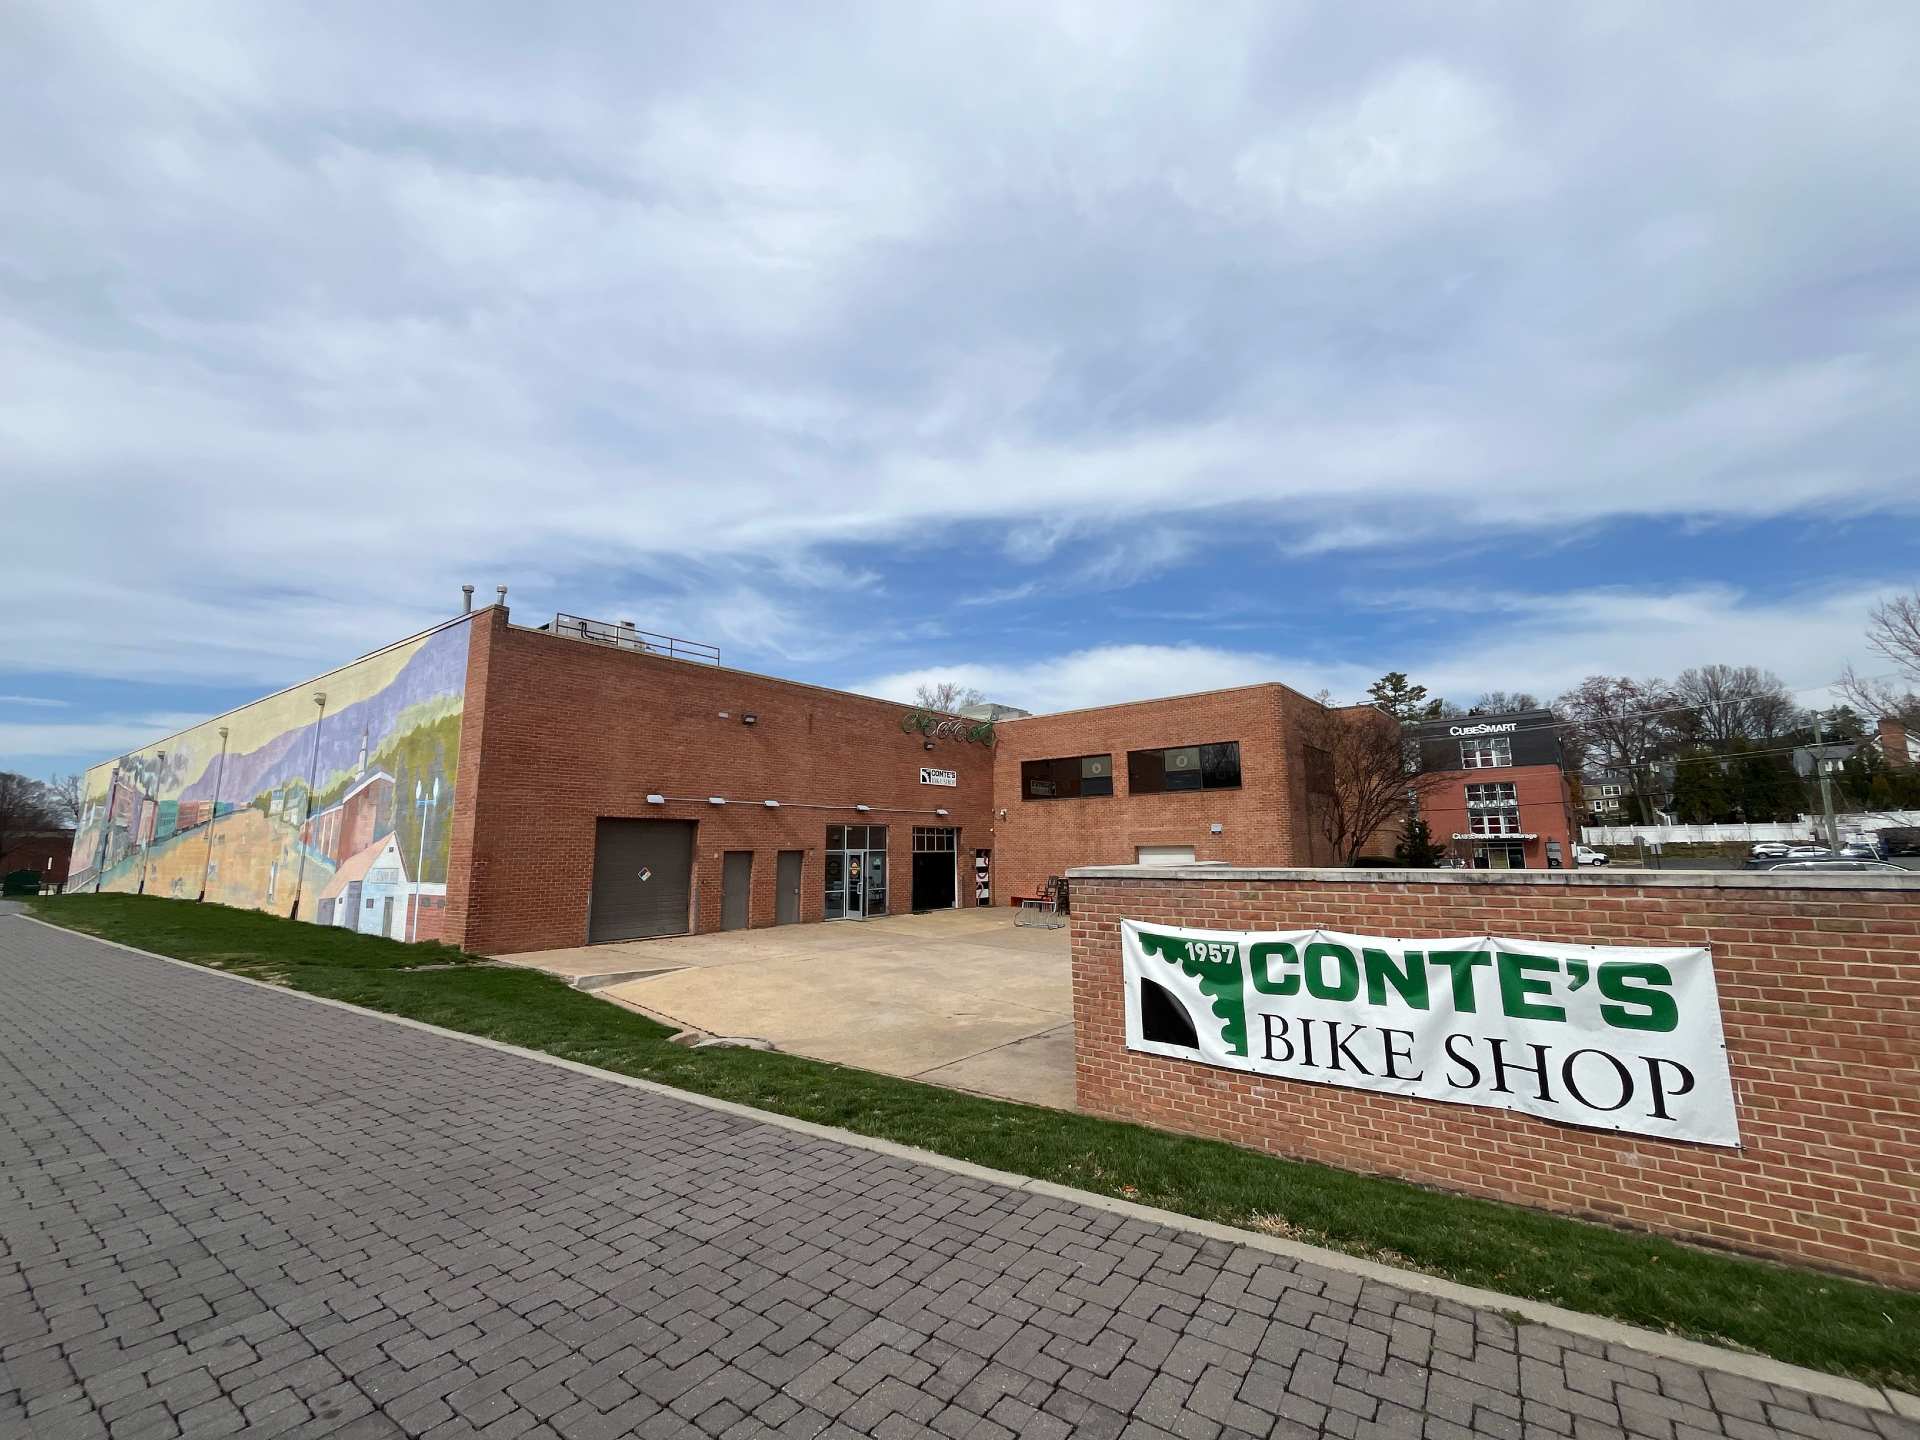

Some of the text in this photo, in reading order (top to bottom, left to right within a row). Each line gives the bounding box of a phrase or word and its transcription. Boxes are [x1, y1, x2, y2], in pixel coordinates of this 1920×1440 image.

[1184, 941, 1235, 964] 1957
[1250, 941, 1679, 1033] CONTE'S
[1258, 1013, 1695, 1121] BIKE SHOP
